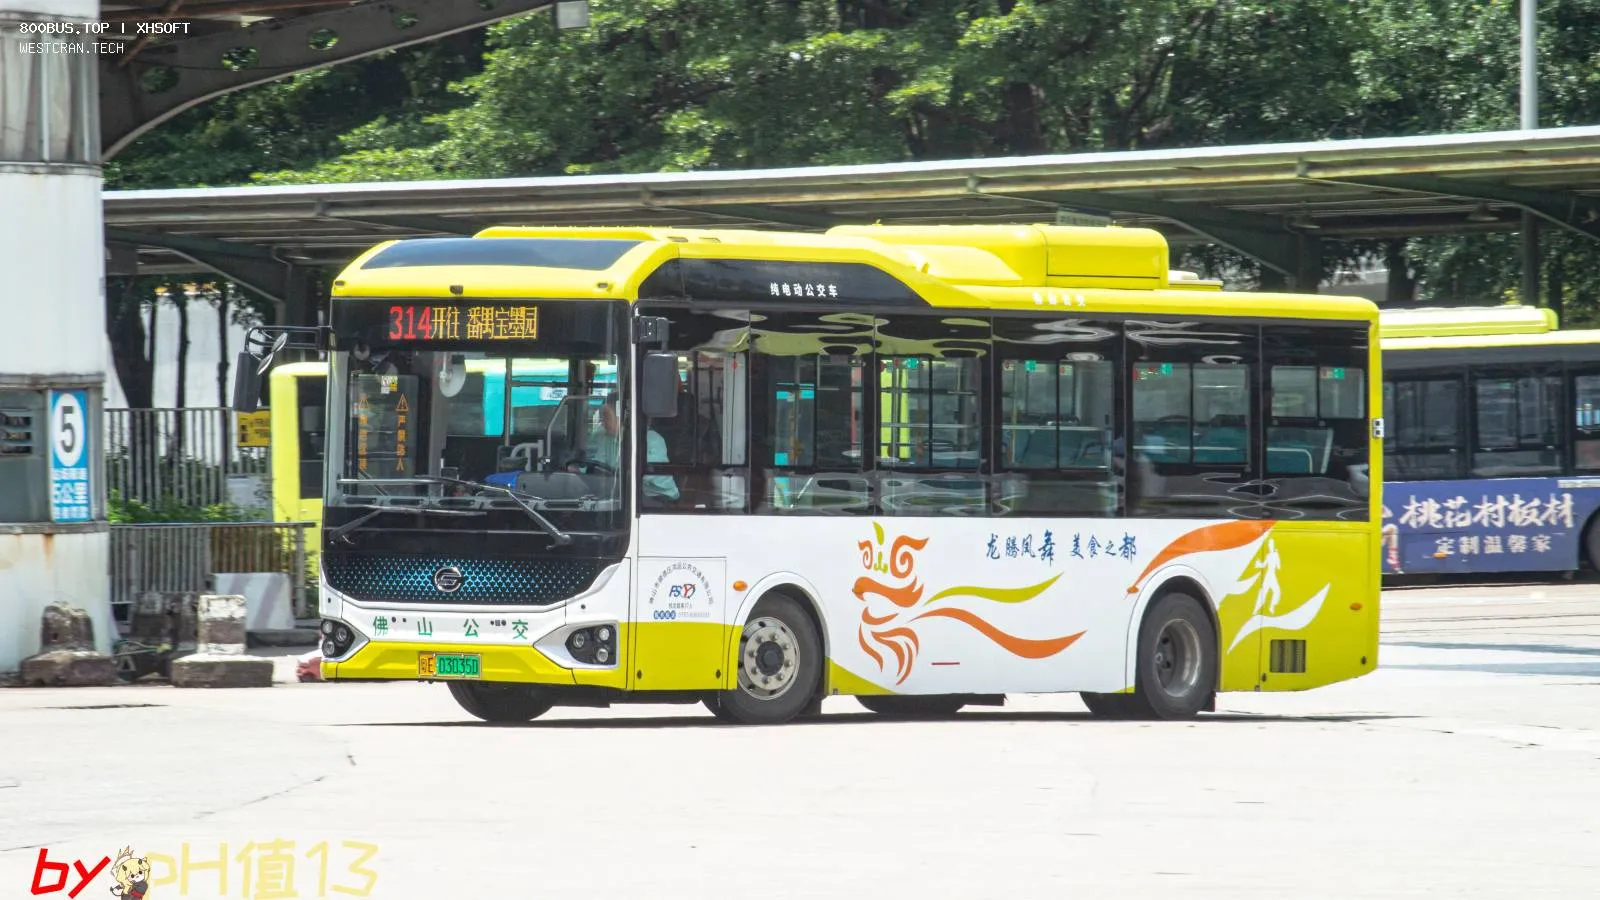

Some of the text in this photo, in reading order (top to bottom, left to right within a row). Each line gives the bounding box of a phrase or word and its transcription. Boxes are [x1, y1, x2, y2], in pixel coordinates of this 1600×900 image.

[770, 282, 838, 298] 纯电动公交车
[389, 306, 431, 340] 314
[467, 306, 538, 340] 番禺宝墨园
[61, 405, 75, 453] 5
[1400, 493, 1575, 528] 桃花村板材
[986, 529, 1137, 567] 龙腾凤舞 美食之都
[1434, 534, 1551, 555] 定制温馨家
[372, 615, 529, 640] 佛山公交
